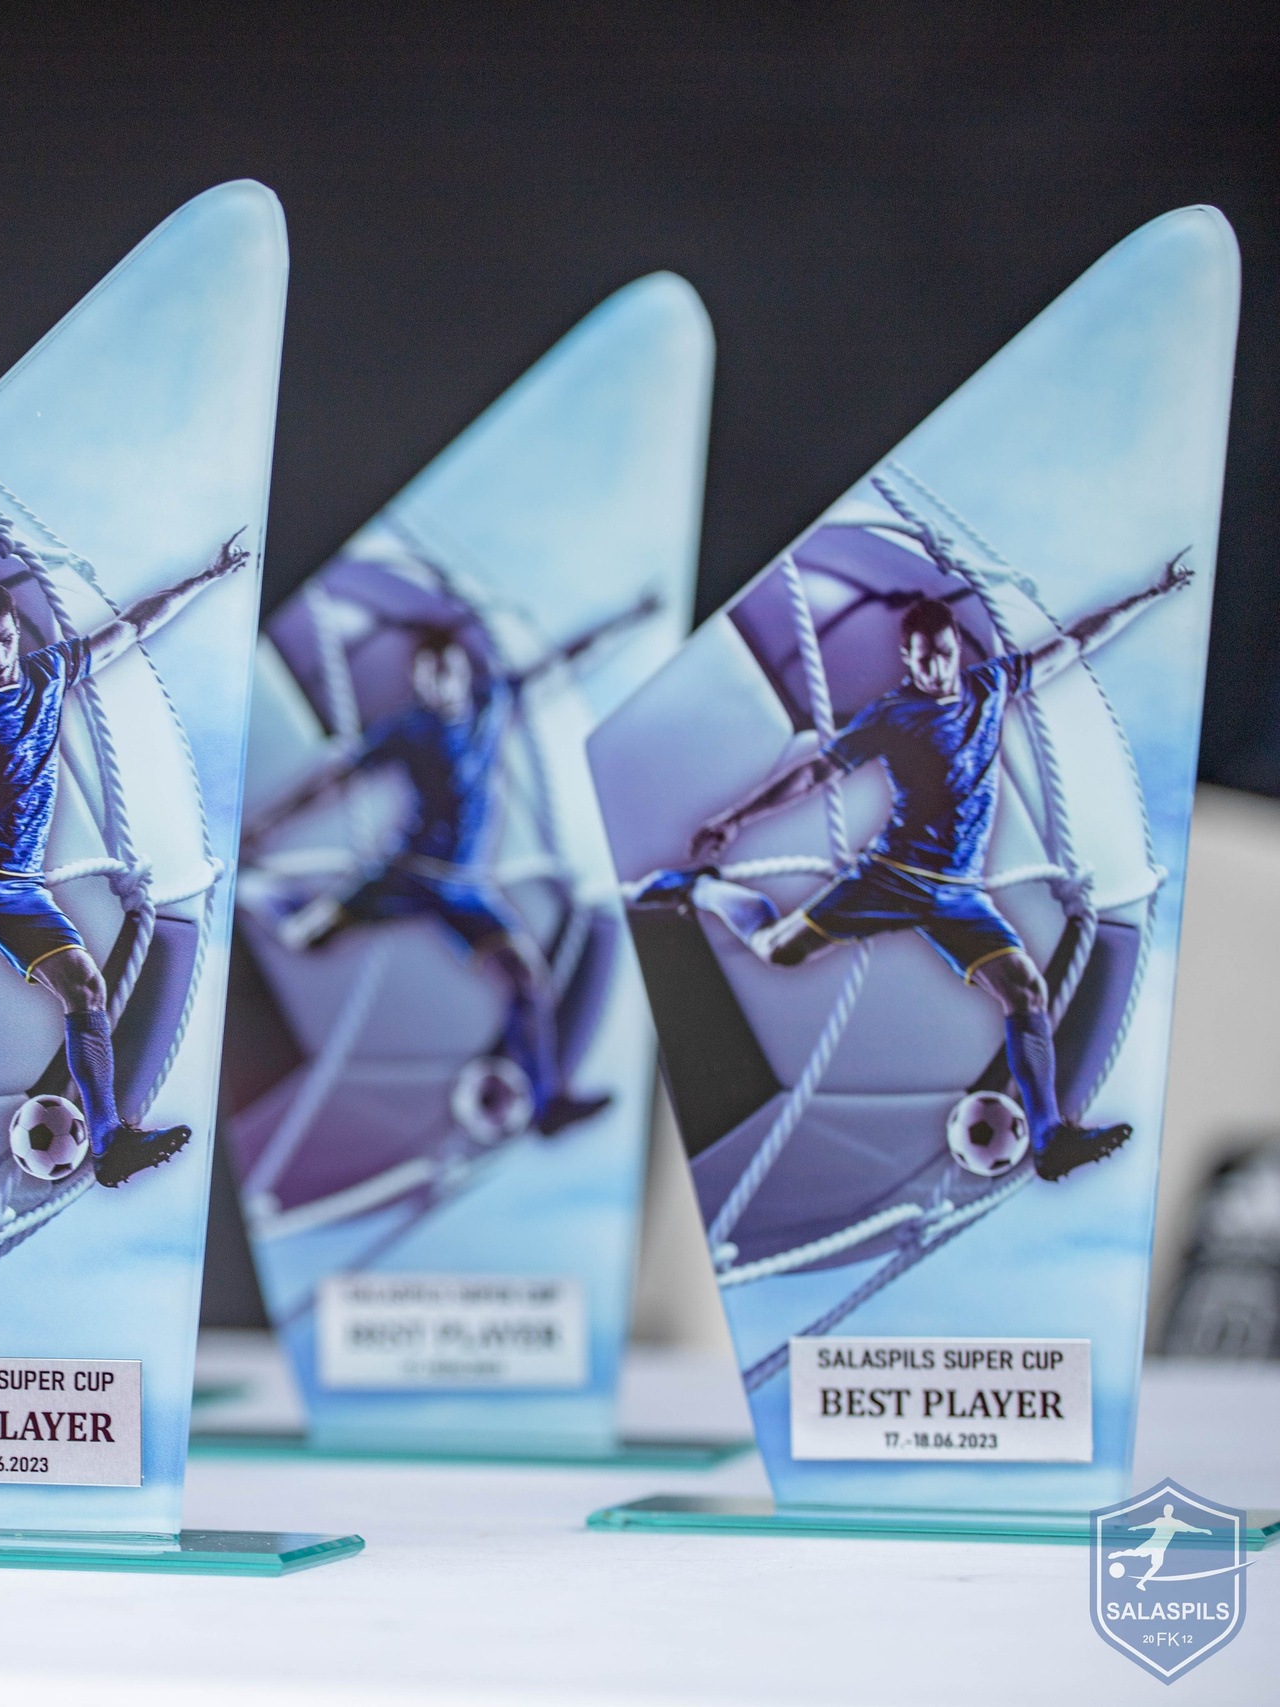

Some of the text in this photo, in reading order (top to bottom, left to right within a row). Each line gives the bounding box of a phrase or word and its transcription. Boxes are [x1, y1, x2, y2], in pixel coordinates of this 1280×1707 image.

[817, 1348, 1064, 1371] SALASPILS SUPER CUP
[73, 1371, 114, 1392] CUP
[820, 1388, 1065, 1420] BEST PLAYER
[884, 1432, 998, 1449] 17.-18.06.2023
